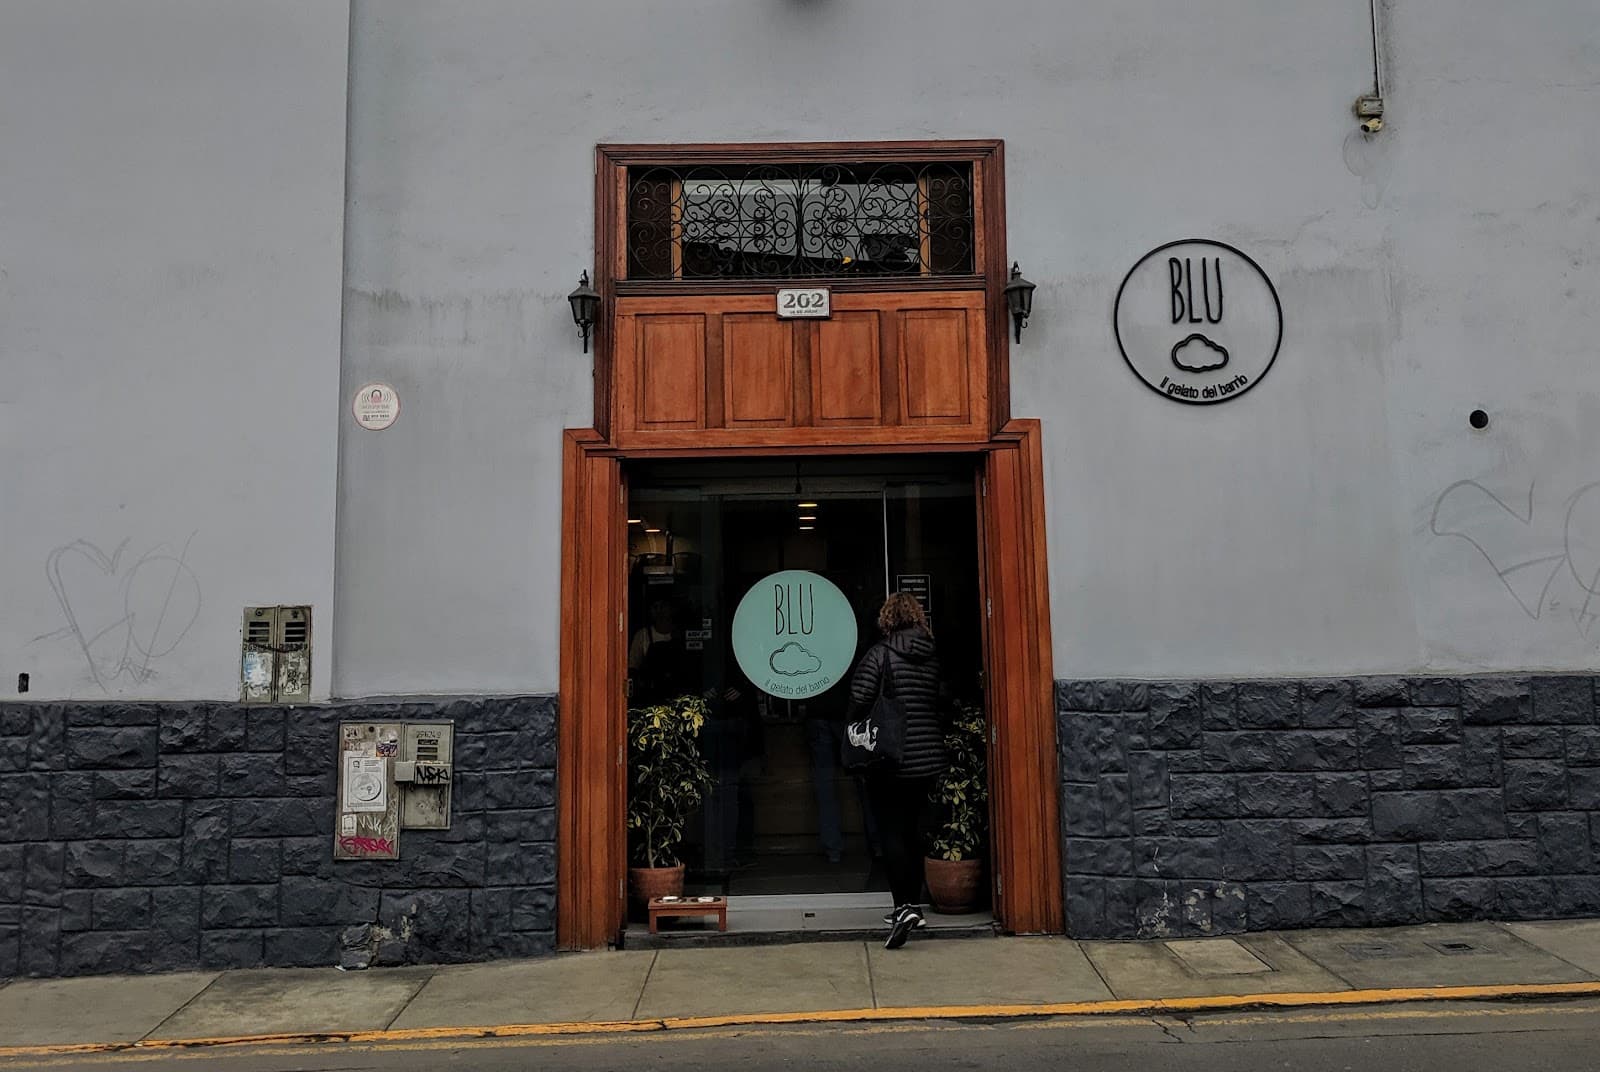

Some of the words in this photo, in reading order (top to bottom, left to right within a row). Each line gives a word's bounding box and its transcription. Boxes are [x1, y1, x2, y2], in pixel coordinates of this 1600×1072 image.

[783, 293, 824, 309] 202
[1168, 257, 1223, 324] BLU
[1167, 383, 1199, 399] gelato
[1202, 384, 1218, 399] del
[1218, 375, 1248, 396] barrio
[774, 583, 814, 635] BLU
[770, 683, 794, 695] gelato
[795, 685, 808, 695] del
